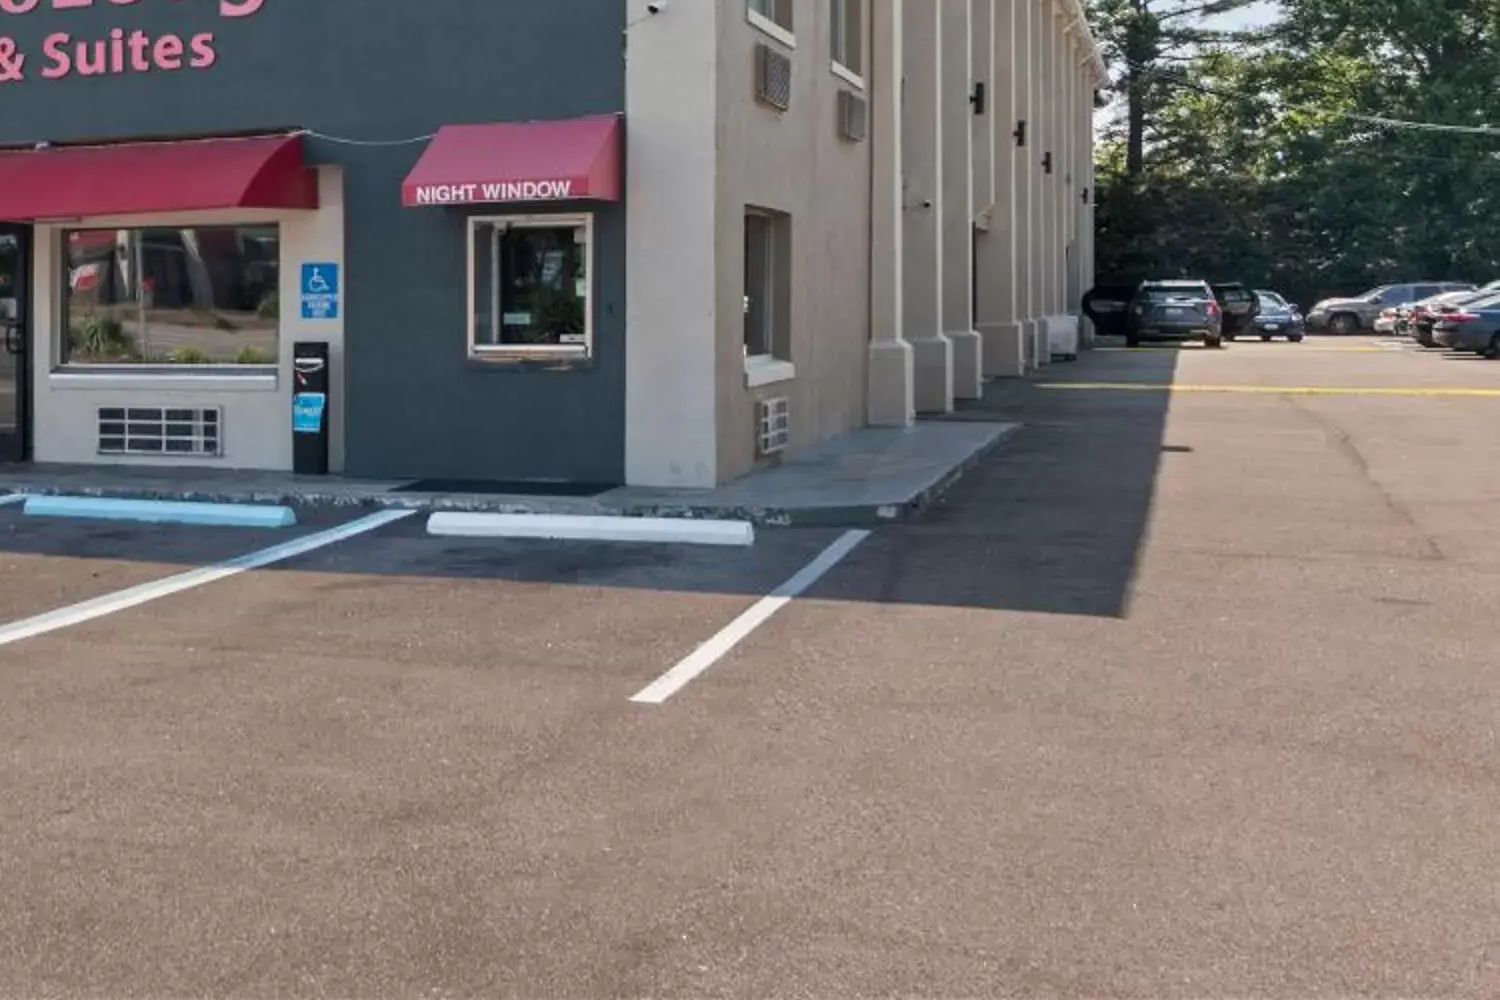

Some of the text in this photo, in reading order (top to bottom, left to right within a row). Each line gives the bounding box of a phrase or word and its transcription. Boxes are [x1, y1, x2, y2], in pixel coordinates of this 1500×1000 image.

[41, 28, 217, 79] Suites
[416, 180, 571, 204] NIGHT WINDOW
